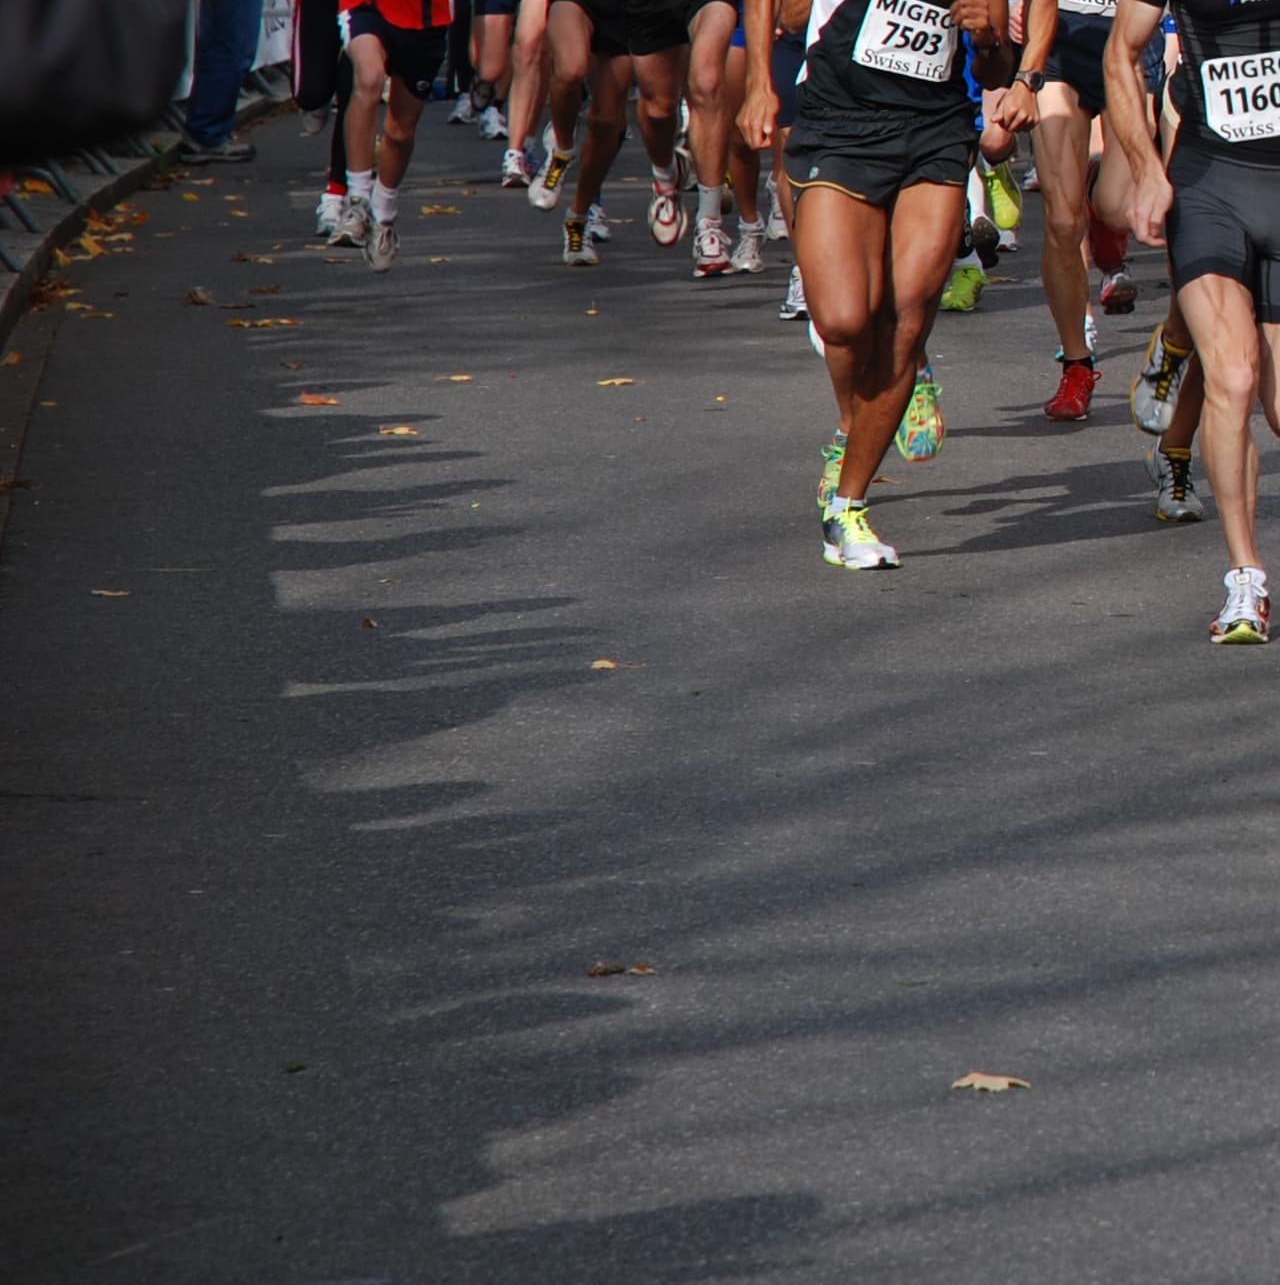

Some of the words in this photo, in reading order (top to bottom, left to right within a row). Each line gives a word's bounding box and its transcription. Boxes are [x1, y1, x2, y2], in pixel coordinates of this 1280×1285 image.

[881, 20, 943, 56] 7503
[861, 48, 911, 73] Swiss
[1220, 120, 1275, 139] Swiss
